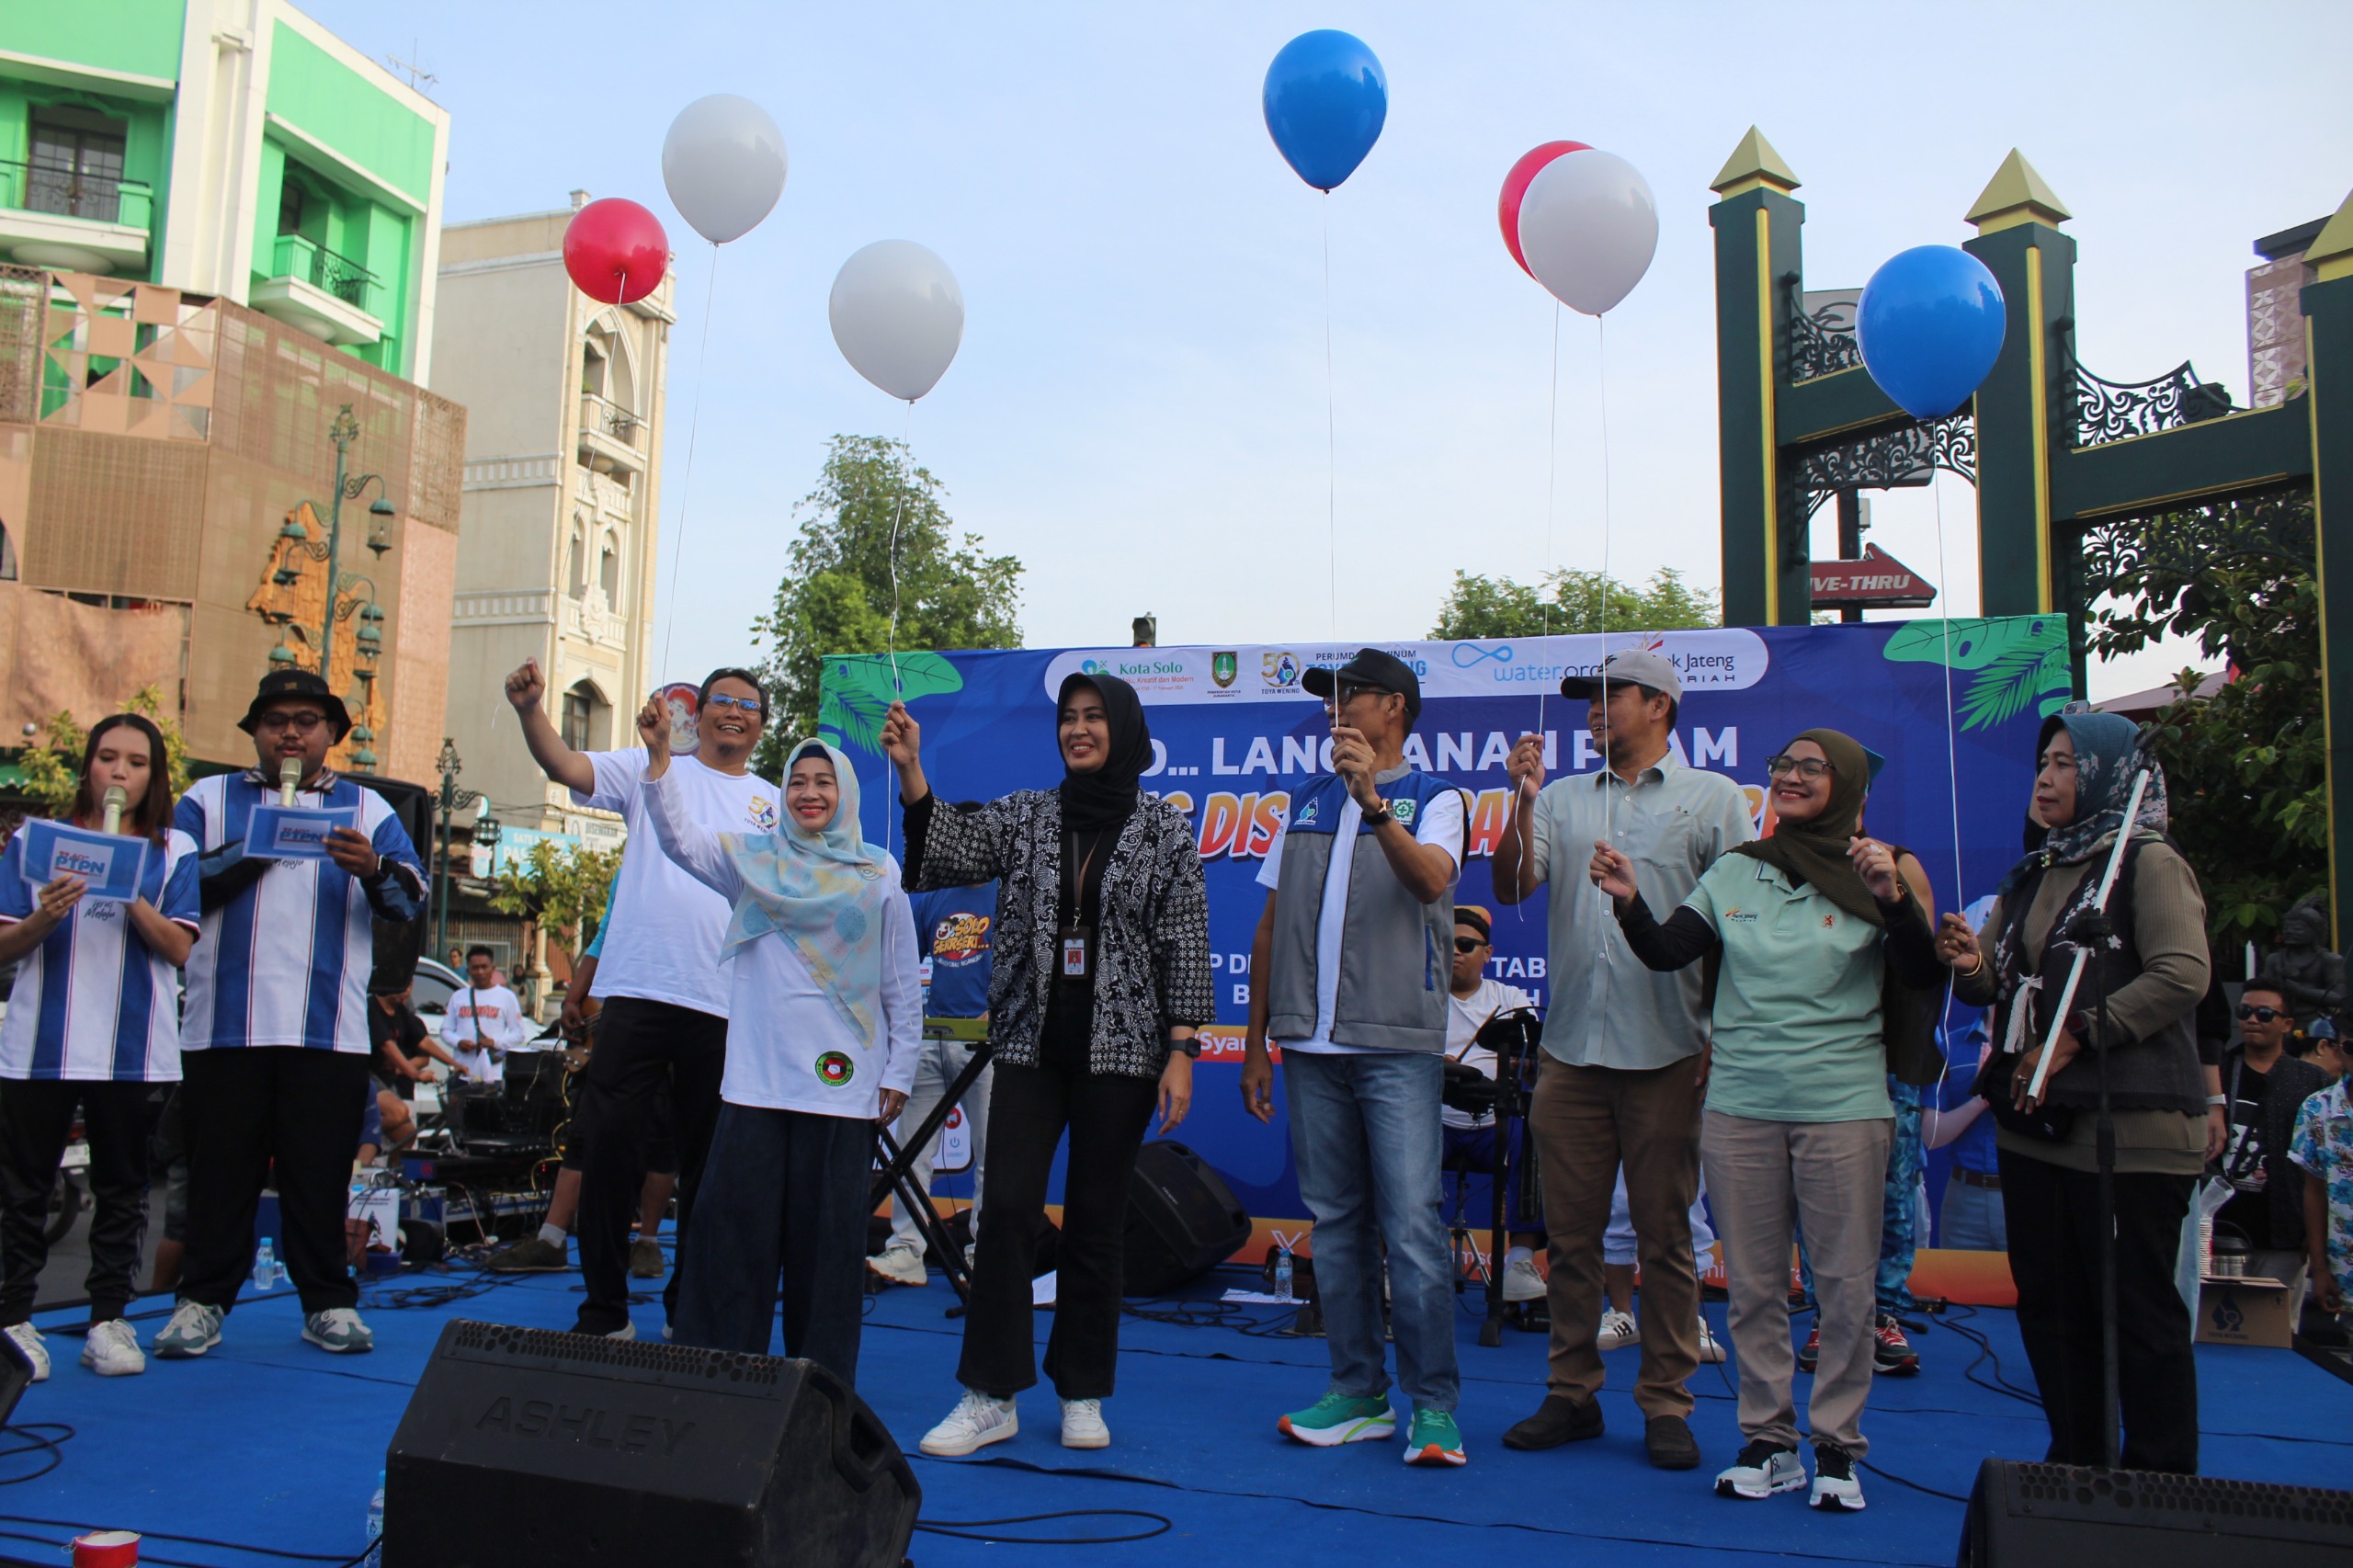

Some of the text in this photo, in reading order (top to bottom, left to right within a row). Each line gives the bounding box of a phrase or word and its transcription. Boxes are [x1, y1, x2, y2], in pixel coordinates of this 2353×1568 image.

[1120, 662, 1183, 675] Kota Solo
[1685, 653, 1734, 672] Jateng
[55, 855, 106, 874] PTPN
[955, 915, 990, 937] SOLO
[474, 1395, 696, 1458] ASHLEY
